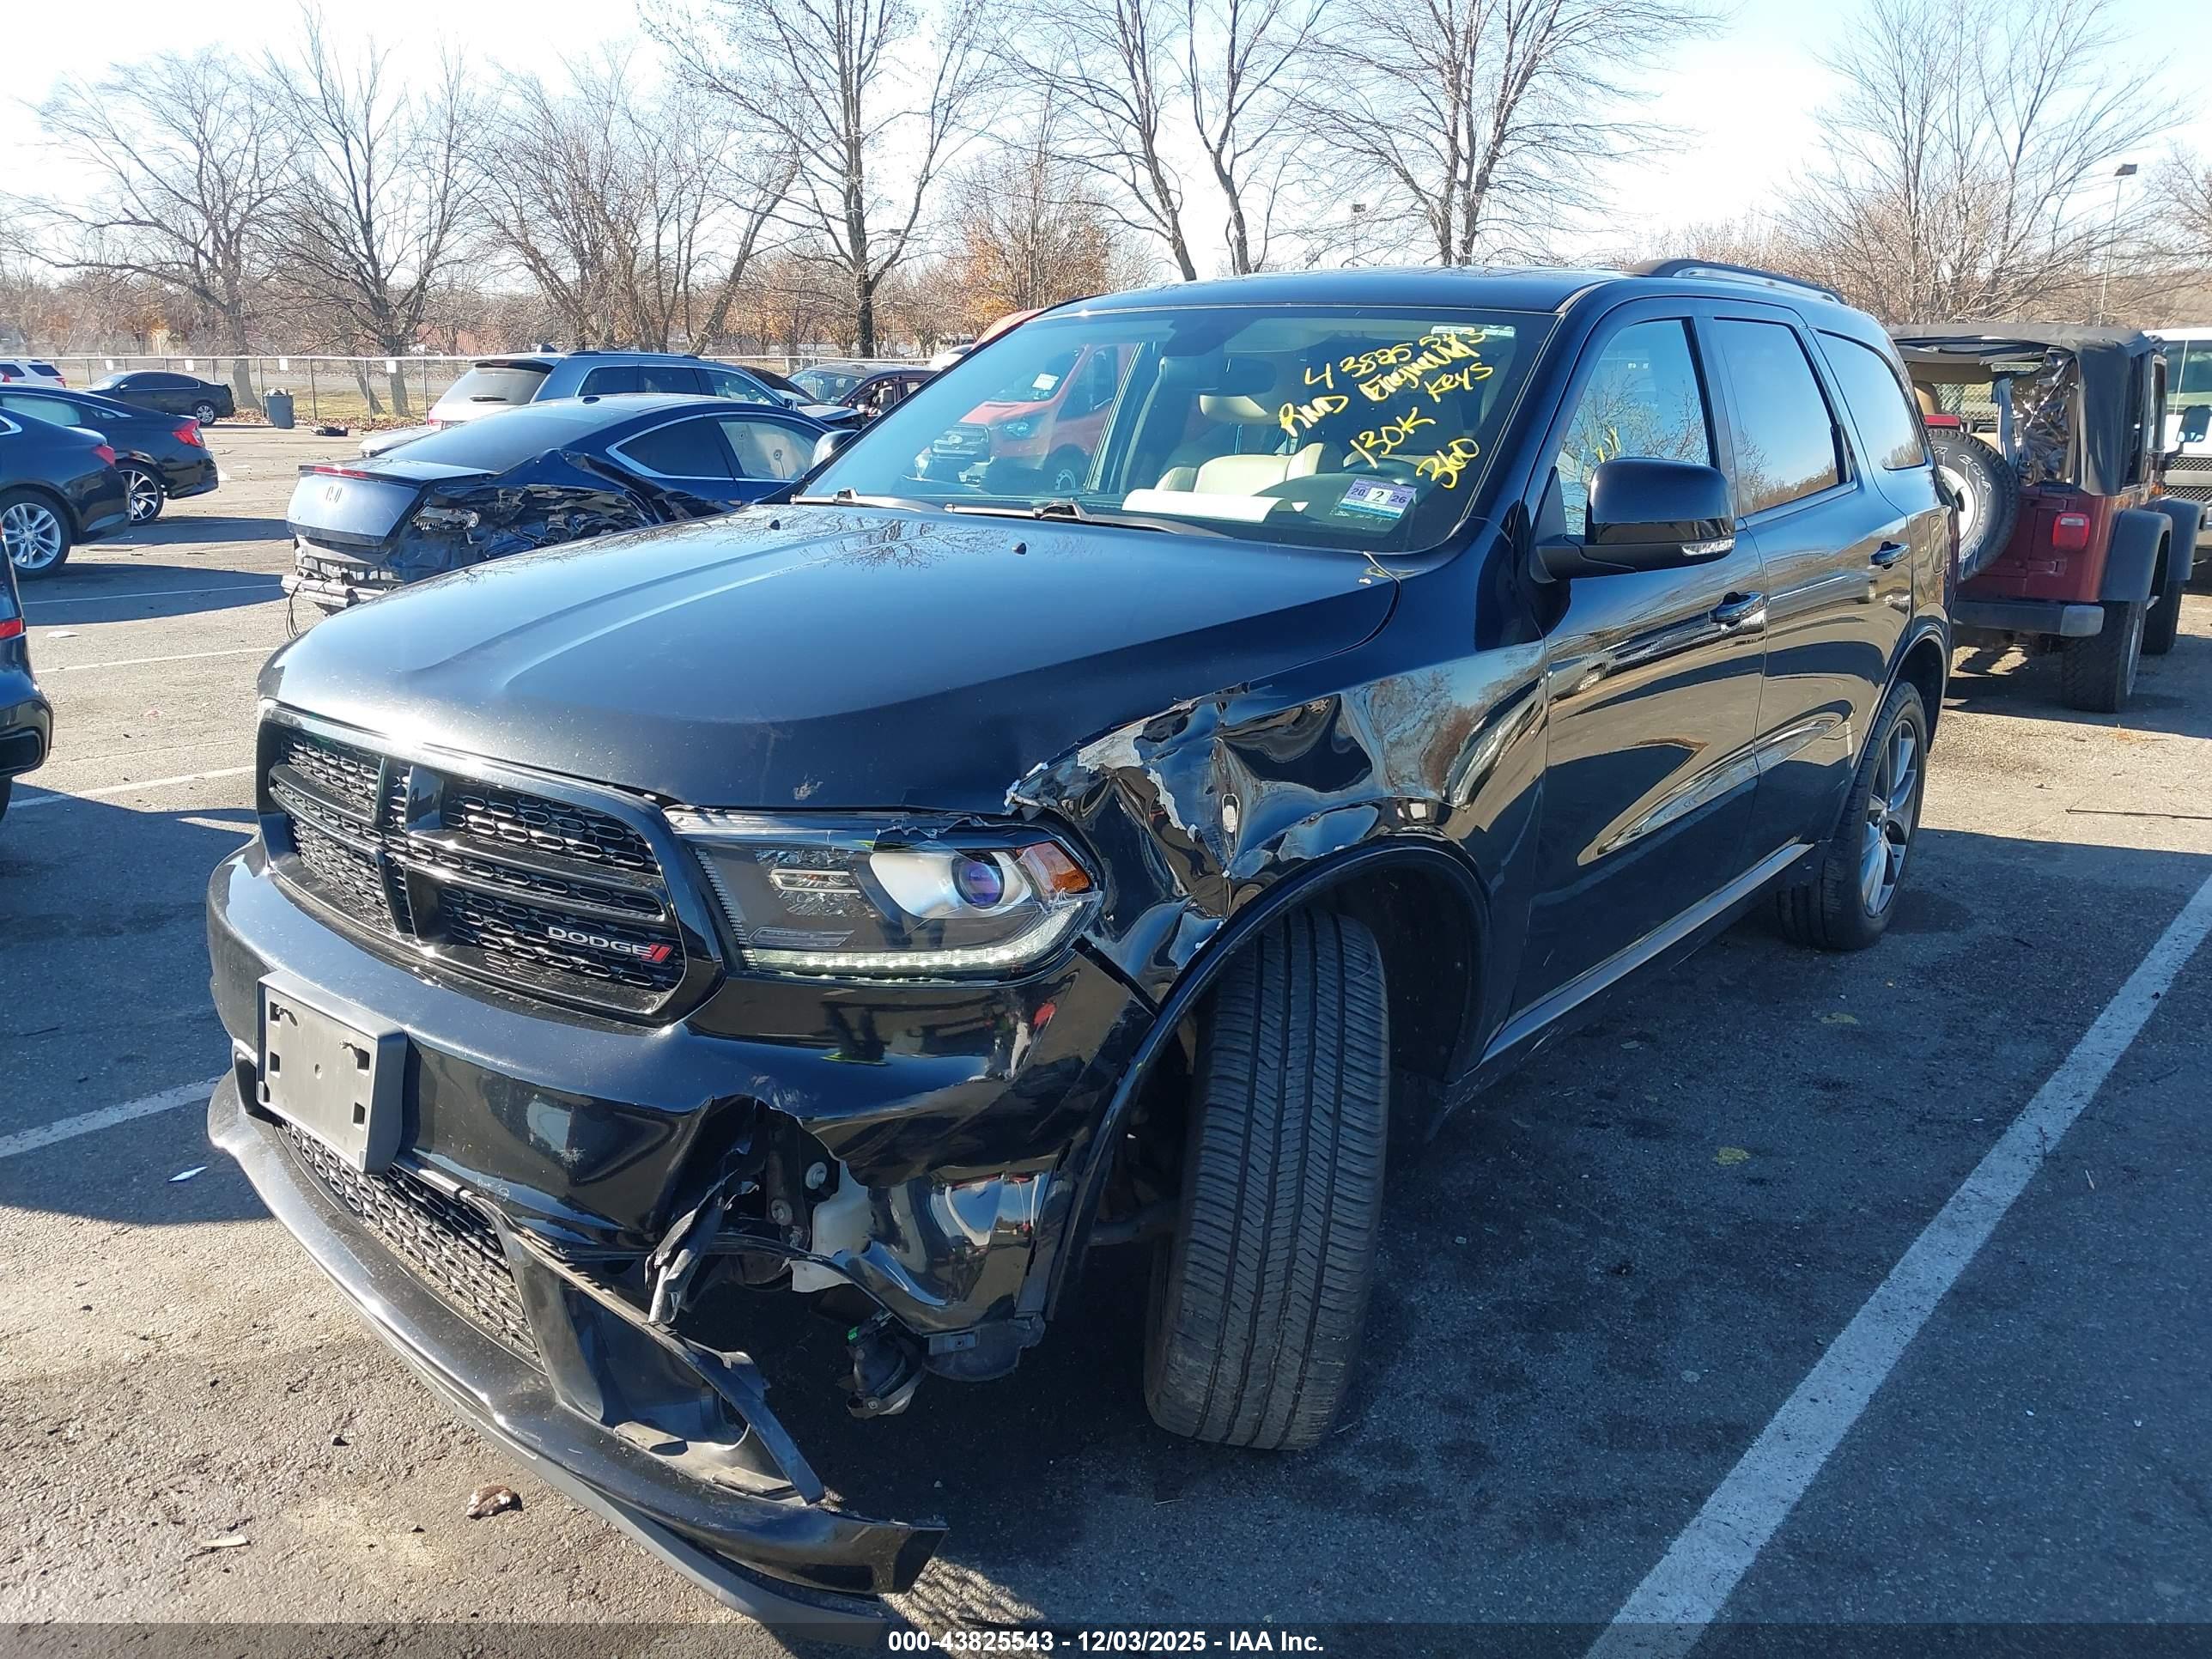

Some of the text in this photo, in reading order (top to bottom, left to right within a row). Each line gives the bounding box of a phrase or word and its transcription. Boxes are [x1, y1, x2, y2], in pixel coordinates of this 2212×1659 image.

[1371, 490, 1385, 502] 2
[1390, 495, 1407, 504] 26
[548, 926, 654, 958] DODGE
